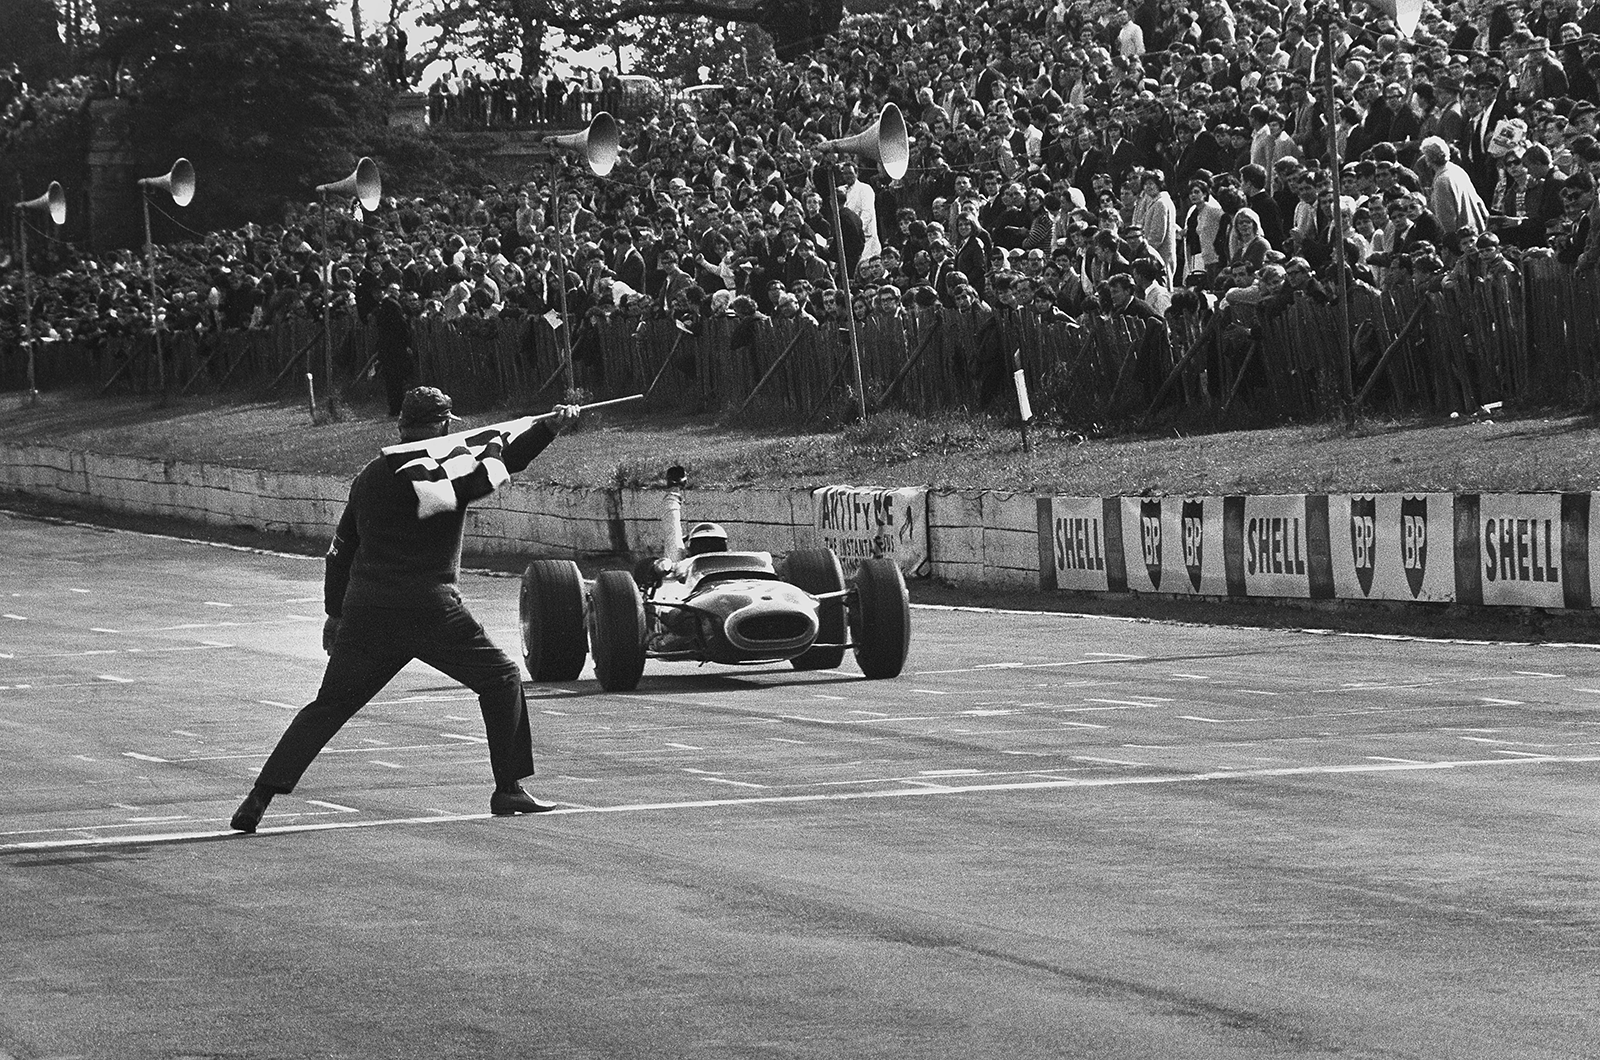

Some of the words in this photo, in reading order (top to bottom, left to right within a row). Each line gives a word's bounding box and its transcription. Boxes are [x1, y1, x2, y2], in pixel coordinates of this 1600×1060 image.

[1055, 517, 1104, 571] SHELL
[1142, 516, 1160, 566] BP
[1184, 516, 1202, 566] BP
[1247, 517, 1306, 576] SHELL
[1353, 515, 1374, 569] BP
[1404, 515, 1426, 569] BP
[1485, 518, 1559, 583] SHELL
